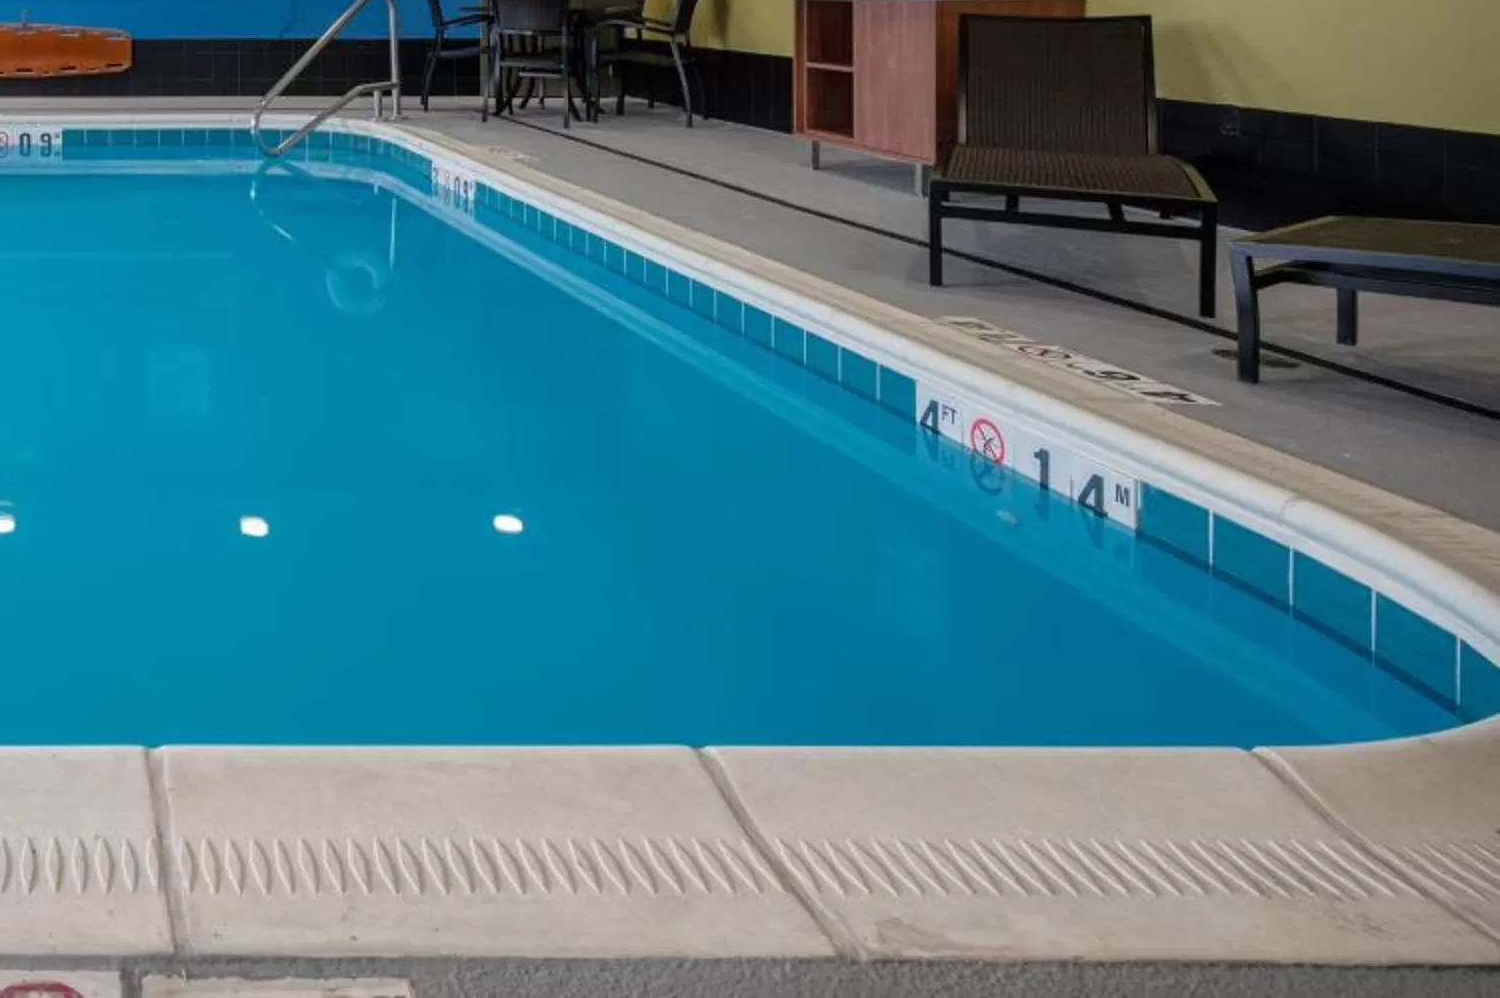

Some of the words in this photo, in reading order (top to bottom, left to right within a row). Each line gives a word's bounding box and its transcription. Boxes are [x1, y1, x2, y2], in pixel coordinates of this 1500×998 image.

[920, 400, 940, 434] 4
[941, 404, 957, 425] FT
[1034, 448, 1050, 490] 1
[1078, 474, 1108, 518] 4
[1115, 484, 1130, 507] M
